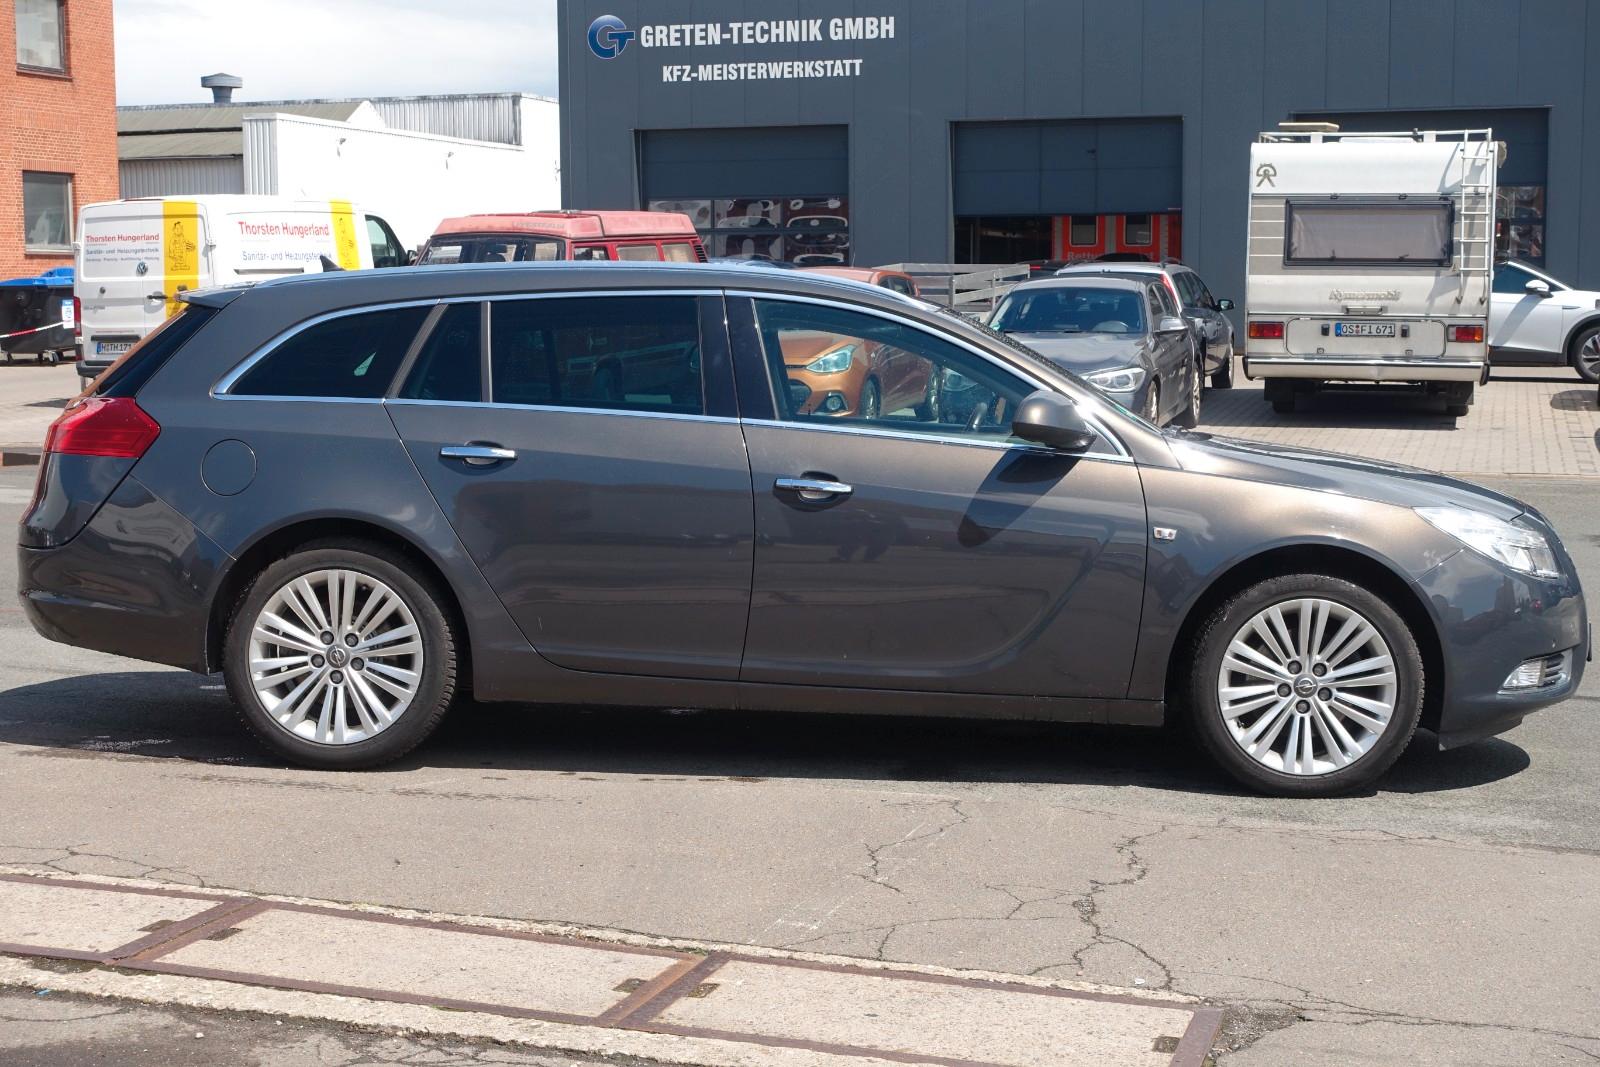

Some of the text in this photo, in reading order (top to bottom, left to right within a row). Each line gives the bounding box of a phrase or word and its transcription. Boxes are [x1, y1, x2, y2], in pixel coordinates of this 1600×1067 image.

[641, 16, 896, 48] GRETEN-TECHNIK GMBH
[662, 59, 864, 82] KFZ-MEISTERWERKSTATT
[86, 233, 160, 243] Thorsten Hungerland
[238, 221, 330, 238] Thorsten Hungerland
[270, 251, 283, 261] und
